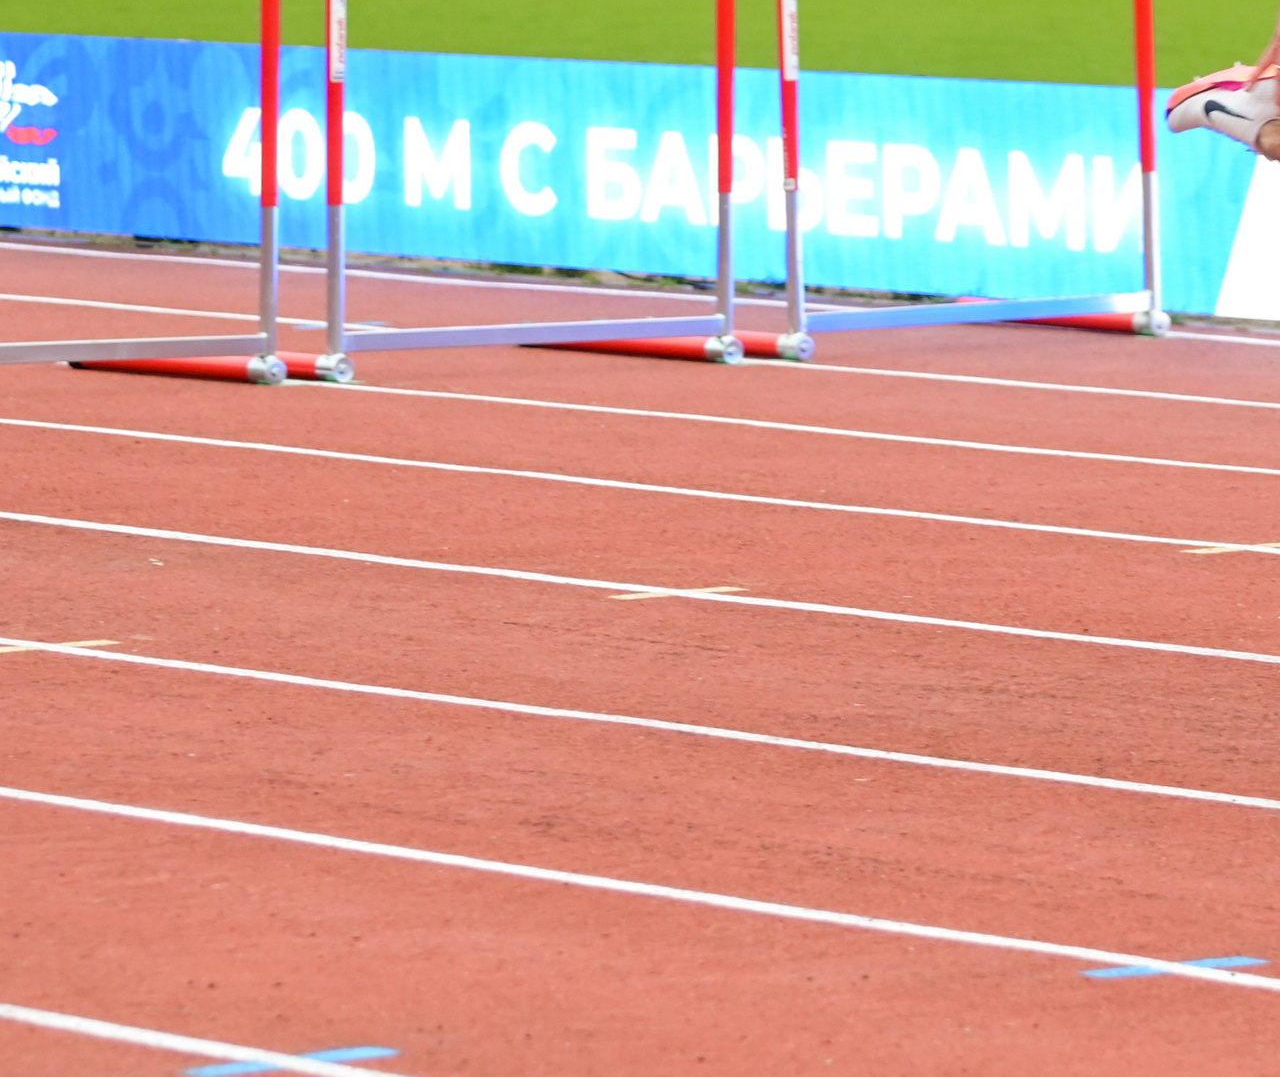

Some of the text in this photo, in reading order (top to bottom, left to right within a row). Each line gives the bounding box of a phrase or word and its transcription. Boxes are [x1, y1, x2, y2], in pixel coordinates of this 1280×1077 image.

[222, 107, 377, 204] 400
[403, 116, 472, 211] М
[499, 120, 558, 217] С
